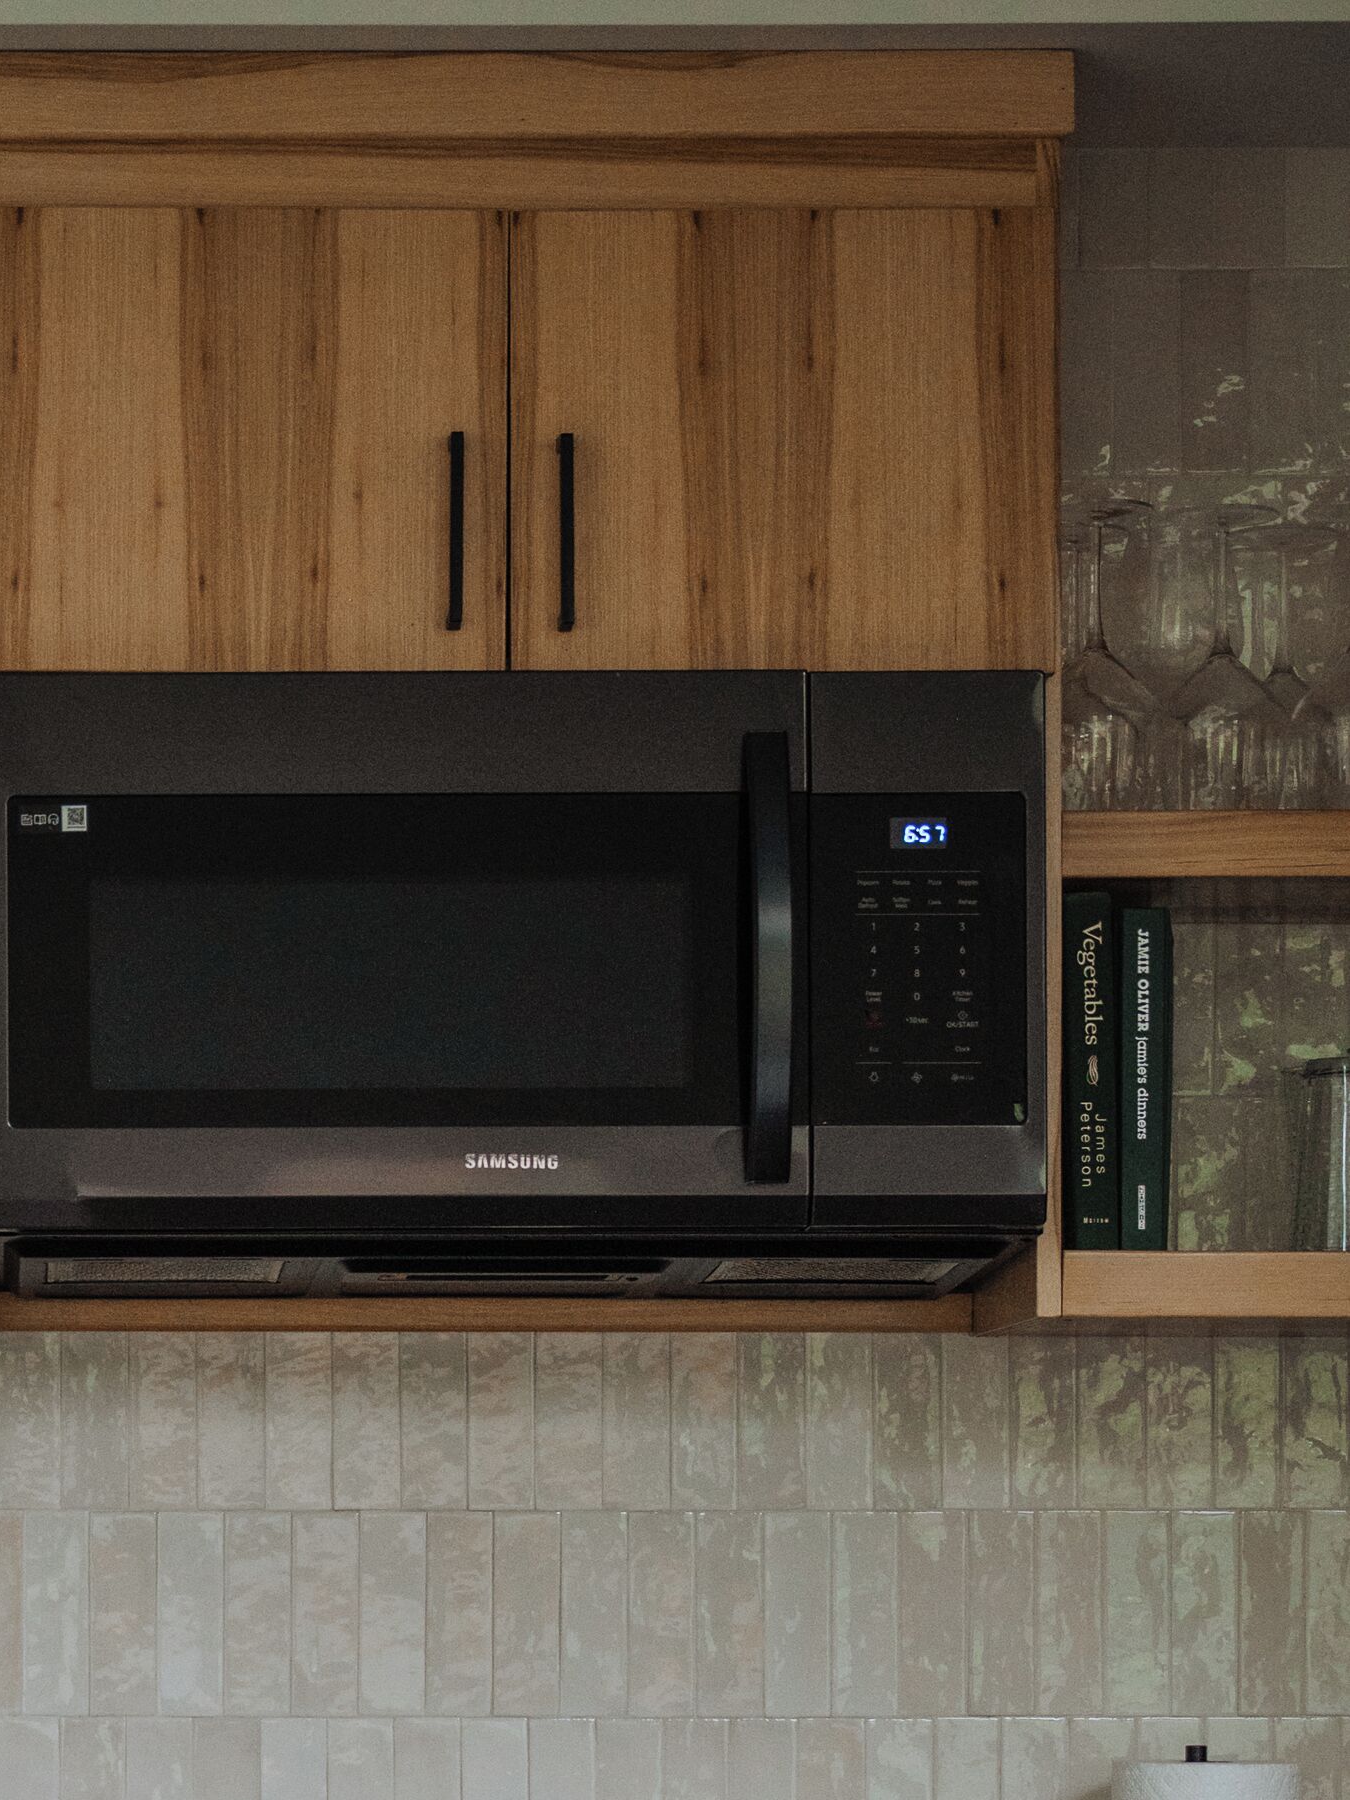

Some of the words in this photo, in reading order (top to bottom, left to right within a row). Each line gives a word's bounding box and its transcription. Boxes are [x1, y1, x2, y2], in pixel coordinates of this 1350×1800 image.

[903, 824, 946, 844] 6:57
[870, 921, 877, 931] 1
[913, 921, 920, 932] 2
[958, 921, 966, 931] 3
[869, 944, 877, 955] 4
[913, 945, 921, 955] 5
[959, 944, 966, 955] 6
[1137, 928, 1150, 975] JAMIE
[870, 968, 877, 977] 7
[913, 968, 921, 978] 8
[959, 968, 966, 977] 9
[1076, 920, 1104, 1046] Vegetables
[1137, 978, 1150, 1032] OLIVER
[1135, 1036, 1149, 1085] jamie's
[1137, 1088, 1149, 1141] dinners
[1080, 1101, 1092, 1188] Peterson
[1094, 1113, 1106, 1175] James
[464, 1153, 559, 1171] SAMSUNG
